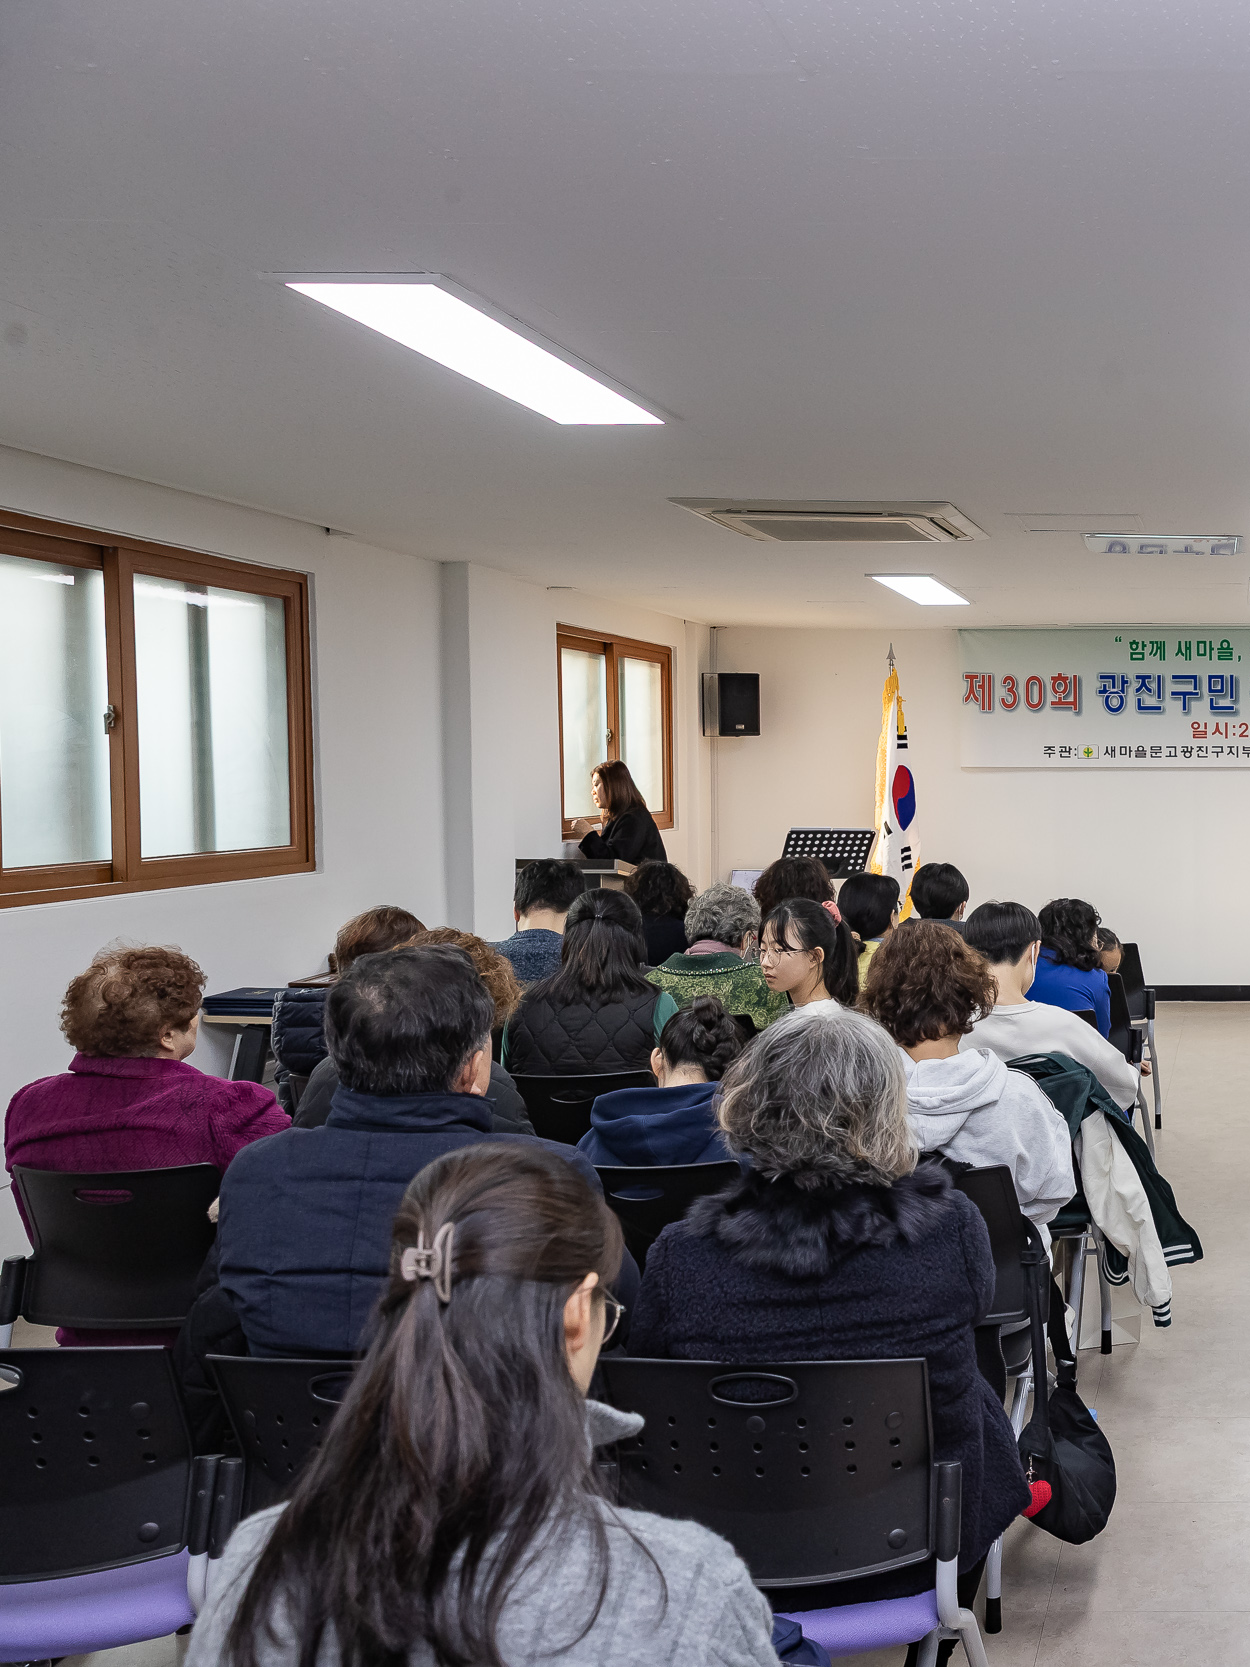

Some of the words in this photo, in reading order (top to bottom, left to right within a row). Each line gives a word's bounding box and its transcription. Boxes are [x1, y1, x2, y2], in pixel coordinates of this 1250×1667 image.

[1175, 639, 1242, 662] 새마을,
[963, 672, 1080, 713] 제30회
[1097, 672, 1236, 714] 광진구민
[1043, 745, 1077, 759] 주관:
